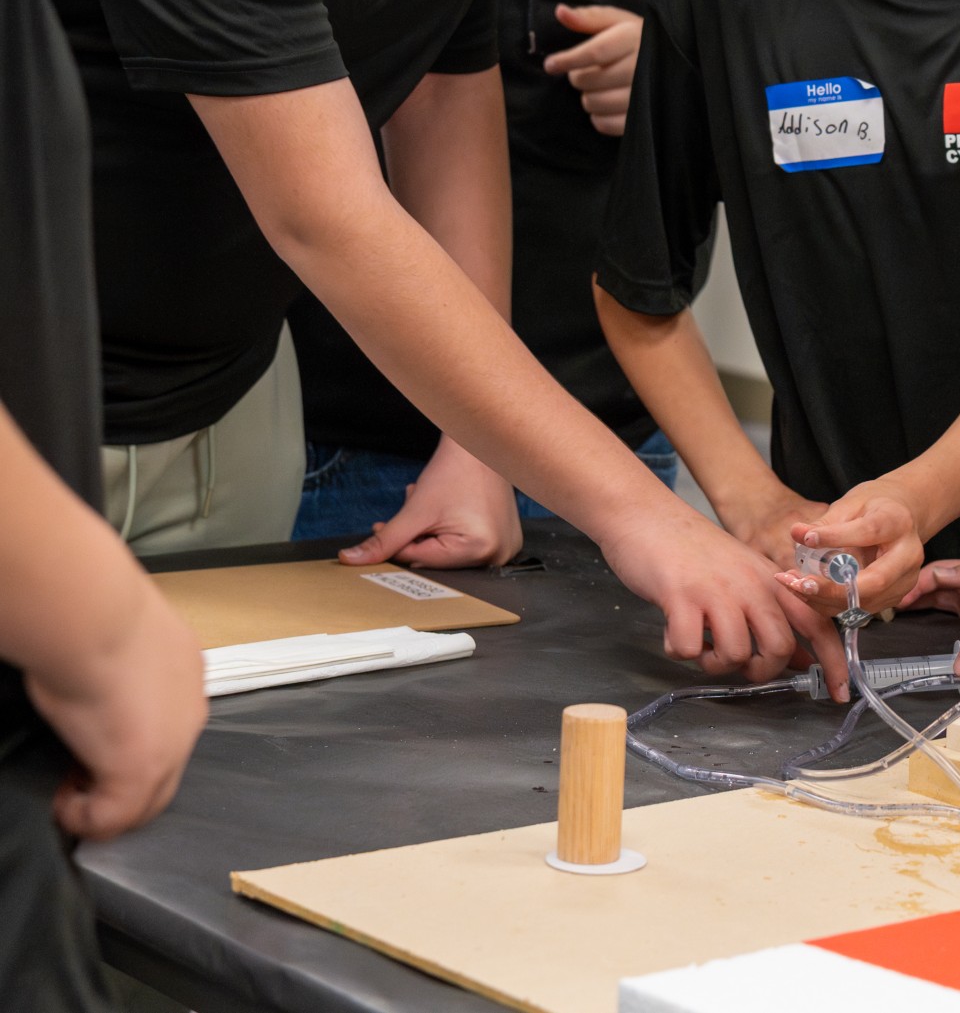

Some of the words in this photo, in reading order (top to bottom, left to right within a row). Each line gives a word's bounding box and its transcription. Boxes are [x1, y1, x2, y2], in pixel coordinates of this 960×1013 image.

[806, 82, 842, 97] Hello
[778, 111, 849, 137] Addison
[857, 121, 872, 140] B.
